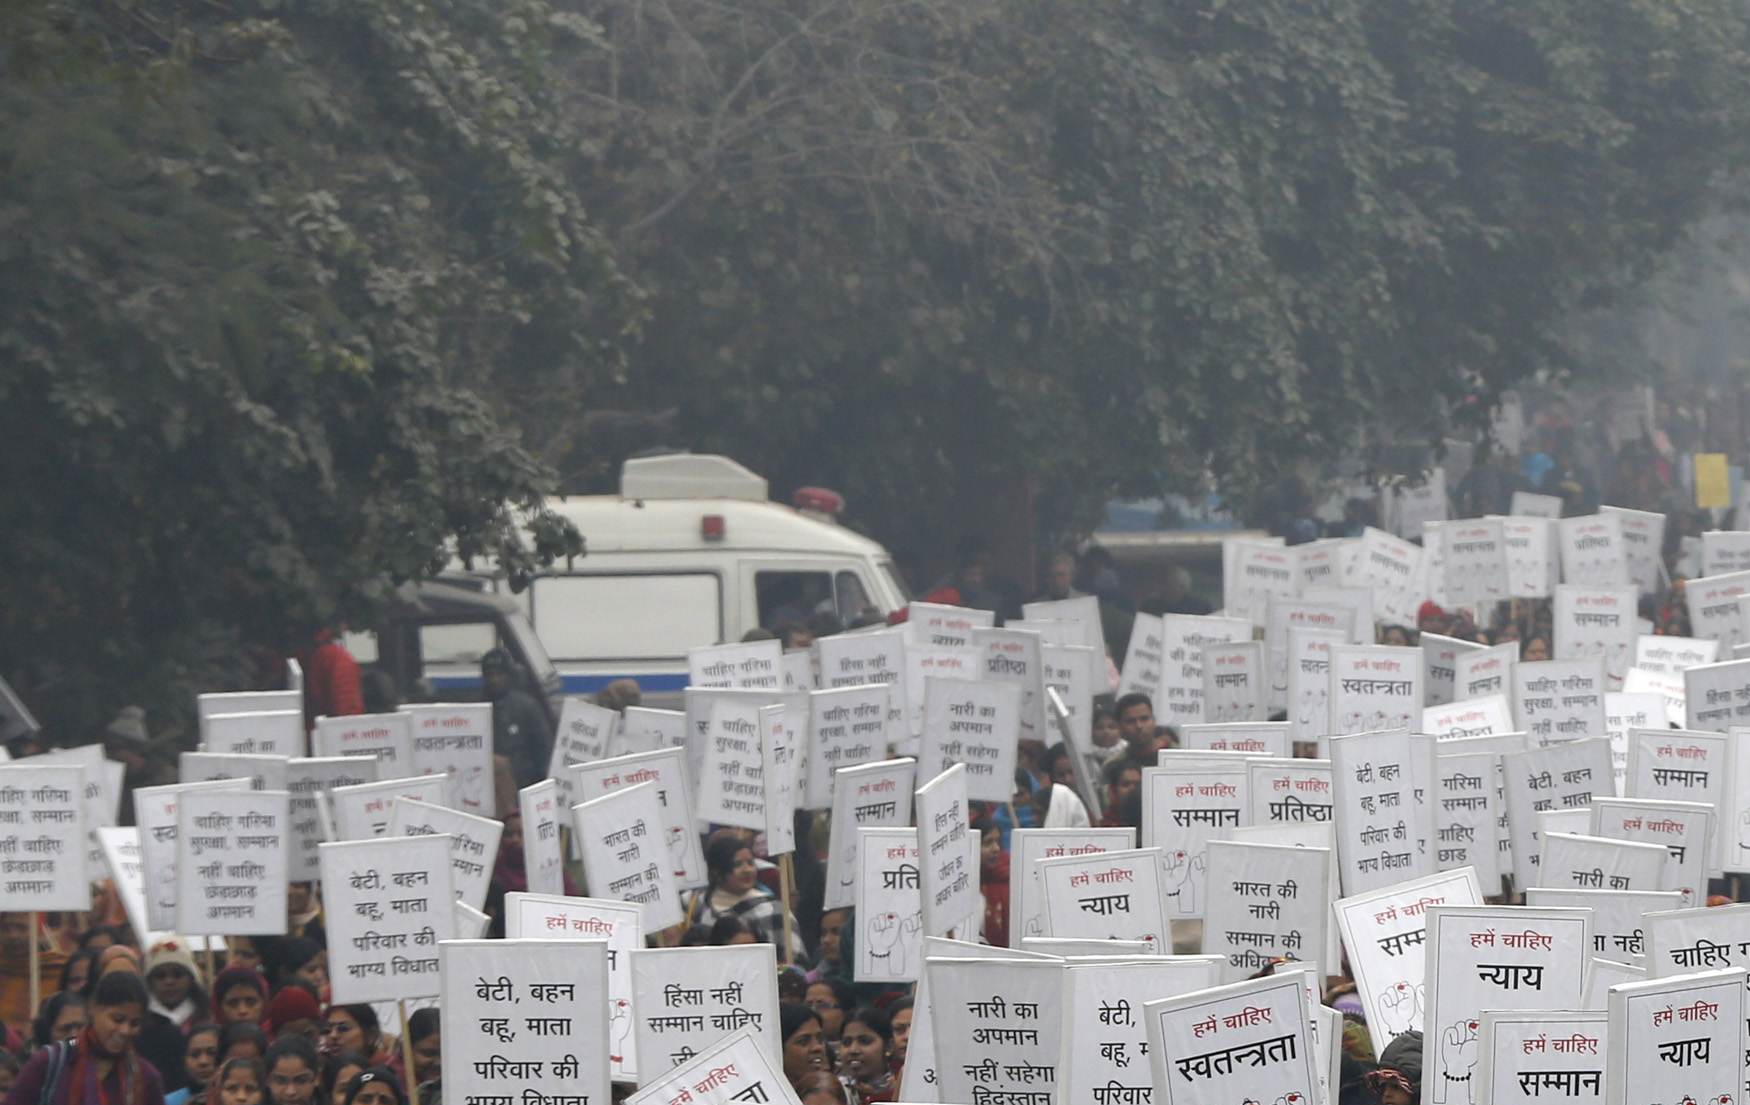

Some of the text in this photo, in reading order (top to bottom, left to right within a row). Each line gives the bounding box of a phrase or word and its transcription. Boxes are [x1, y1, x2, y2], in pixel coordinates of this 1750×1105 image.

[1273, 776, 1329, 793] हमें चाहिए
[1442, 773, 1481, 790] गरिमा
[1653, 769, 1708, 788] सम्मान
[1176, 783, 1236, 797] हमें चाहिए
[855, 802, 896, 822] सम्मान
[1172, 809, 1240, 827] सम्मान
[1269, 795, 1333, 822] प्रतिष्ठा
[1070, 868, 1133, 887] हमें चाहिए
[1233, 880, 1297, 899] भारत की
[390, 898, 427, 913] माता
[1078, 895, 1129, 915] न्याय
[1249, 901, 1280, 920] नारी
[546, 914, 612, 937] हमें चाहिए
[353, 931, 407, 950] परिवार
[1226, 930, 1301, 949] सम्मान की
[1470, 929, 1552, 951] हमें चाहिए
[1670, 940, 1730, 967] चाहिए
[1477, 965, 1544, 990] न्याय
[475, 977, 575, 1004] बेटी, बहन
[664, 981, 743, 1007] हिंसा नहीं
[967, 996, 1038, 1019] नारी का
[1099, 1000, 1135, 1027] बेटी,
[1653, 1001, 1718, 1027] हमें चाहिए
[479, 1019, 571, 1042] बहू, माता
[648, 1016, 703, 1032] सम्मान
[1192, 1007, 1271, 1038] हमें चाहिए
[973, 1029, 1038, 1045] अपमान
[1523, 1034, 1598, 1055] हमें चाहिए
[1100, 1043, 1130, 1067] बहू,
[1175, 1034, 1296, 1082] स्वतन्त्रता
[1658, 1038, 1711, 1067] न्याय
[473, 1054, 579, 1079] परिवार की
[963, 1058, 1054, 1084] नहीं सहेगा
[1517, 1071, 1602, 1096] सम्मान
